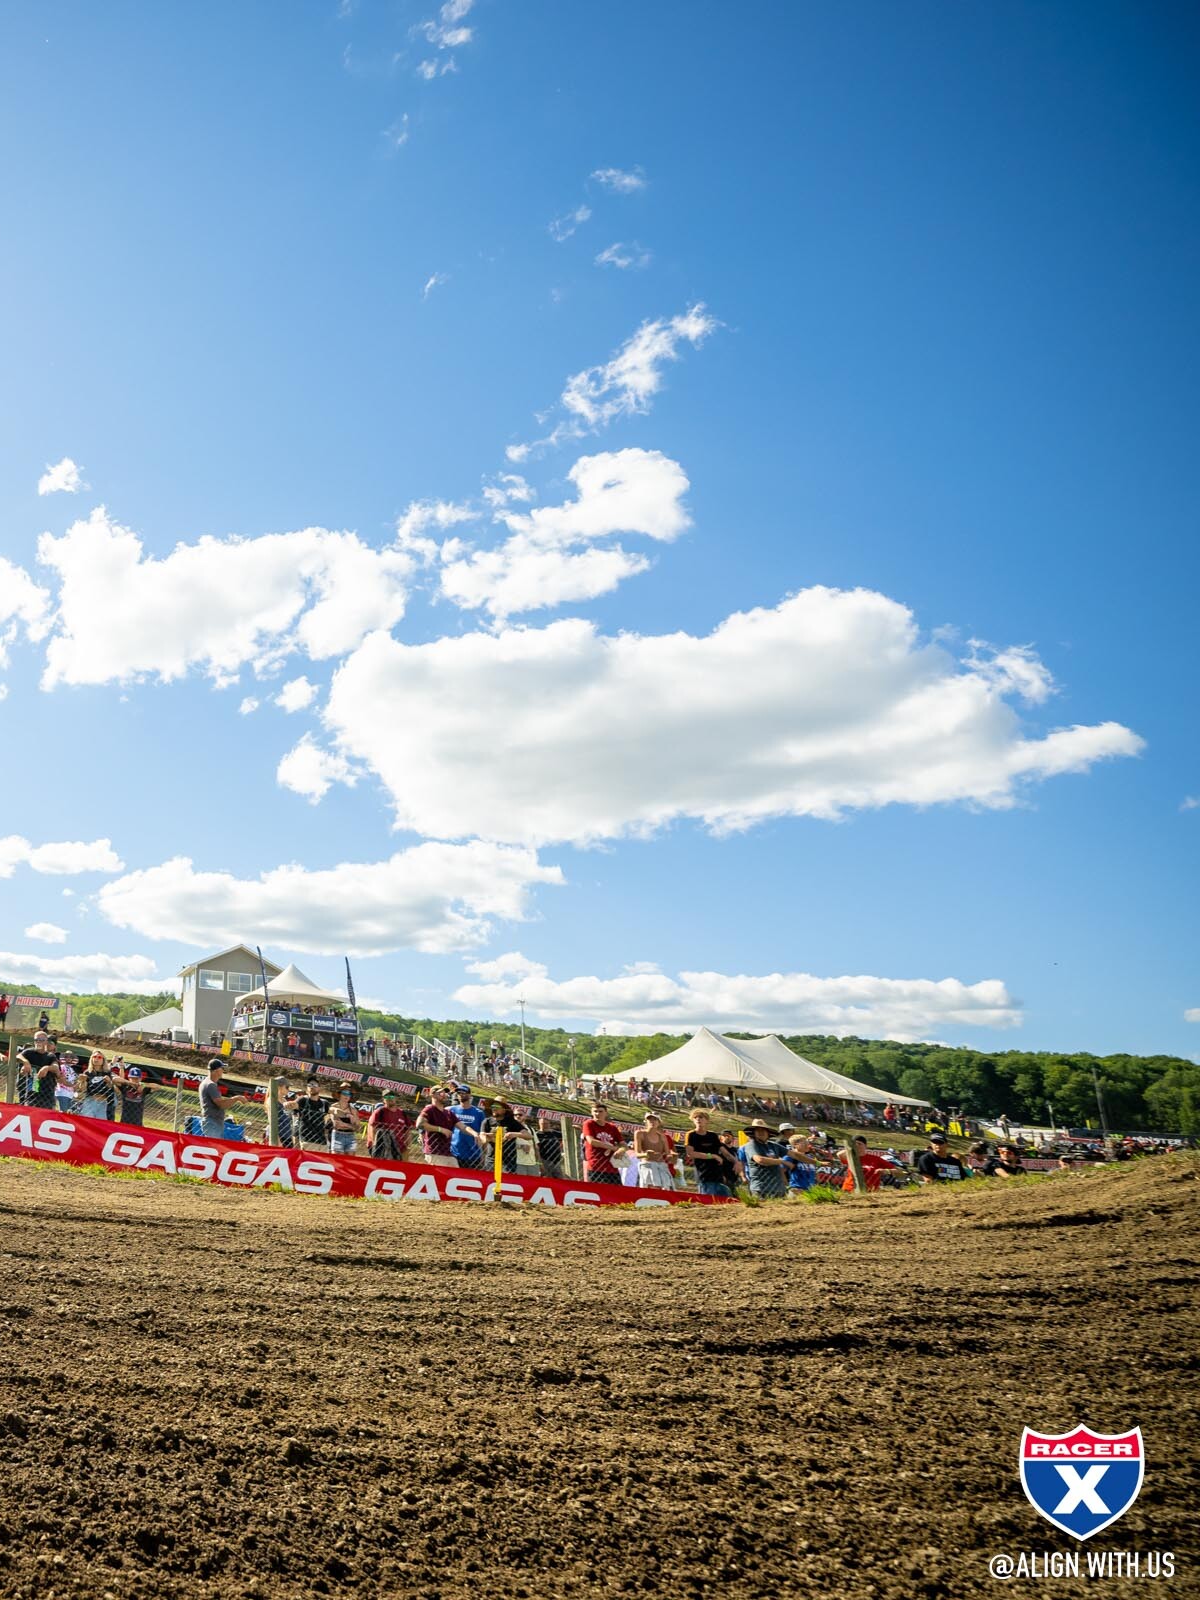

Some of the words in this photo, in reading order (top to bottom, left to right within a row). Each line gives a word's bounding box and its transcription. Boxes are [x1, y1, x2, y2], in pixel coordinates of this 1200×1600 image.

[15, 996, 55, 1007] HOLESHOT
[173, 1070, 208, 1082] MX-AT
[317, 1066, 362, 1081] MOTOSPORT
[368, 1077, 415, 1094] MOTOSPORT
[101, 1132, 335, 1195] GASGAS
